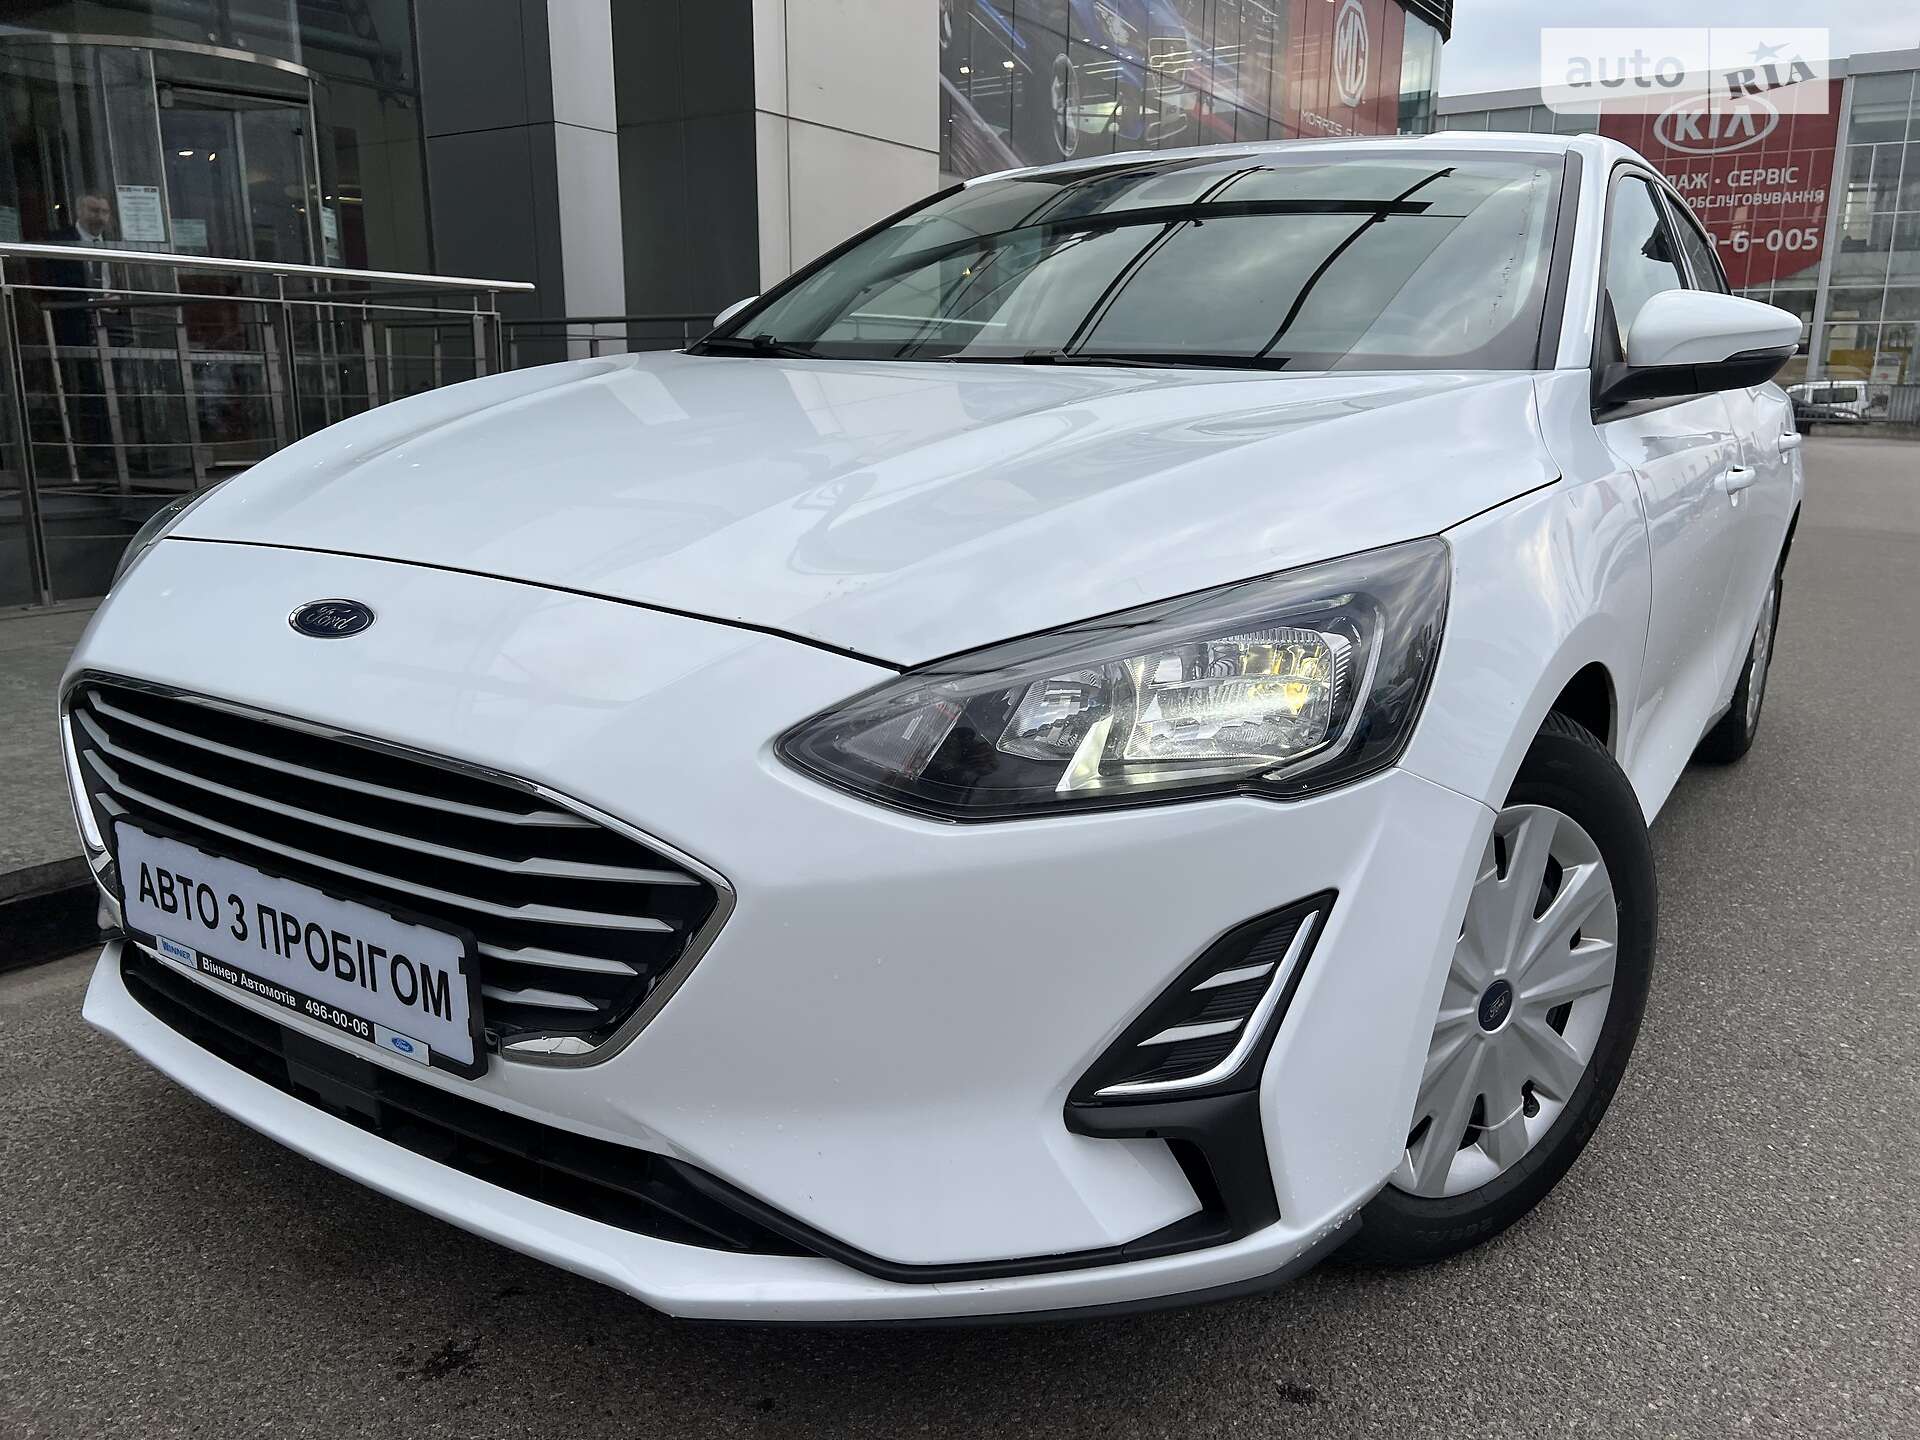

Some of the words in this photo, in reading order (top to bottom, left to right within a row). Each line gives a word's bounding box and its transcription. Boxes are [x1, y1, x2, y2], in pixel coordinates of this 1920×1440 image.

[1338, 11, 1365, 94] MG
[1674, 107, 1756, 142] KIA
[1727, 167, 1799, 187] СЕРВІС
[1687, 189, 1825, 209] ОБСЛУГОВУВАННЯ
[139, 862, 220, 930] АВТО
[257, 903, 452, 1022] ПРОБІГОМ
[161, 938, 193, 963] WINNER
[202, 956, 238, 984] Віннер
[240, 973, 296, 1007] Автомотів
[305, 999, 369, 1037] 496-00-06
